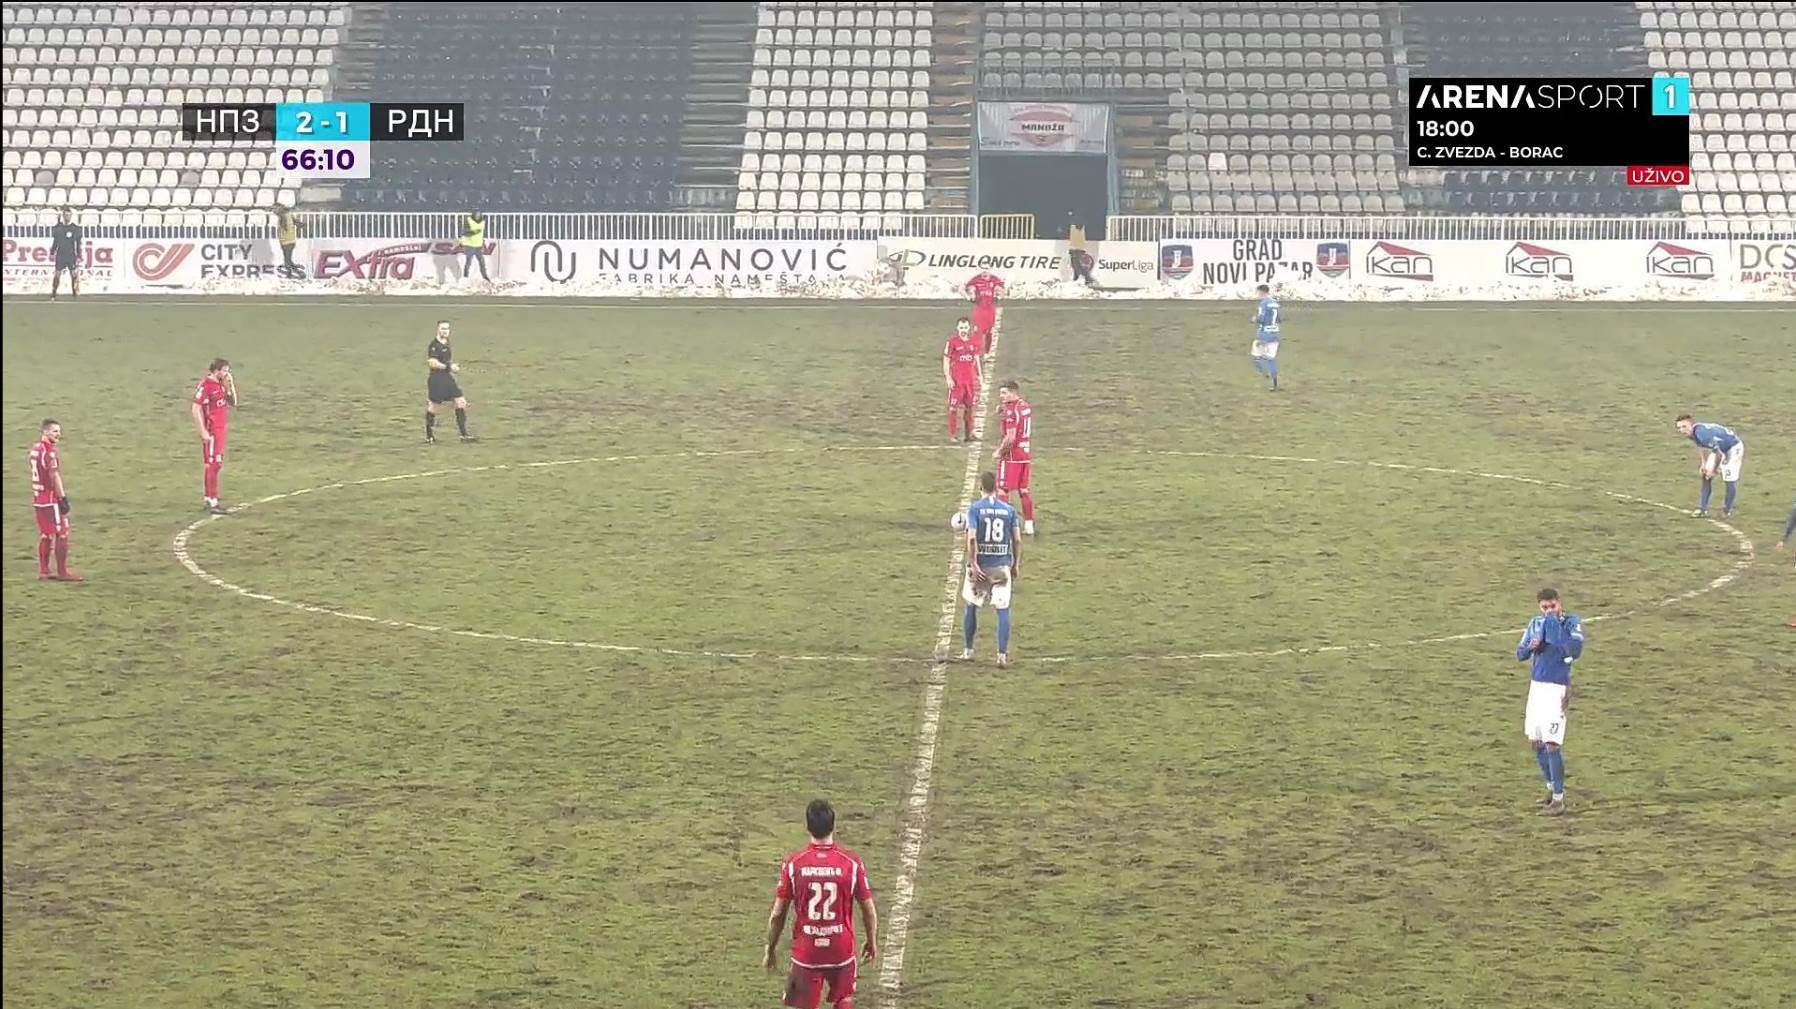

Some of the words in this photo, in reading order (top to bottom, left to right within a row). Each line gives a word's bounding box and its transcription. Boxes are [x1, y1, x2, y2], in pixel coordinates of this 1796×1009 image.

[201, 244, 252, 261] CITY
[599, 242, 847, 271] NUMANOVIĆ
[1233, 239, 1283, 261] GRAD
[1020, 255, 1062, 270] TIRE
[1098, 259, 1154, 273] SuperLiga
[1203, 262, 1247, 284] NOVI
[984, 517, 1004, 543] 18
[808, 882, 838, 920] 22
